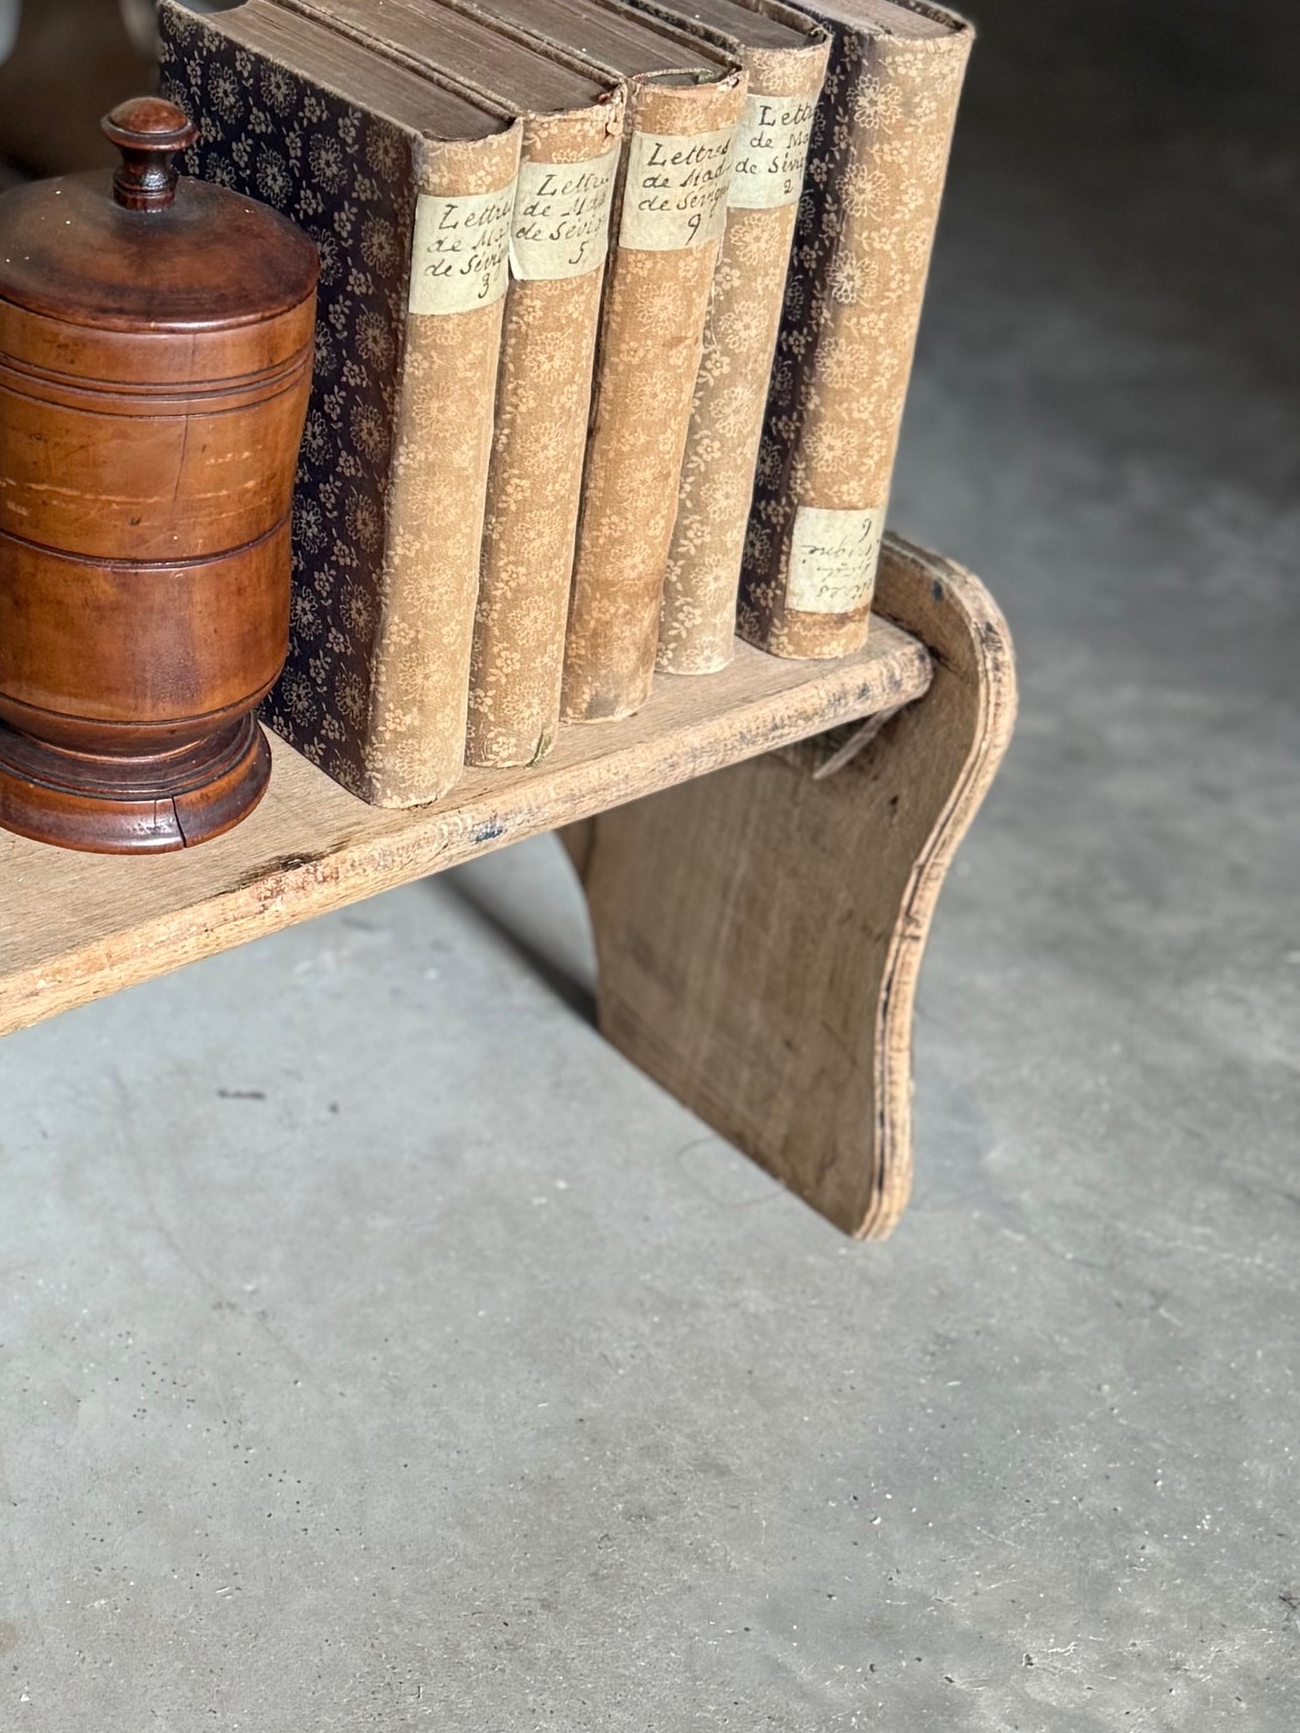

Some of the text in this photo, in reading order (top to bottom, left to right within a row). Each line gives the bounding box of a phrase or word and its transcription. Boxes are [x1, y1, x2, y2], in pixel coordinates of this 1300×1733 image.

[750, 131, 774, 148] de
[647, 137, 732, 167] Lettres
[735, 157, 758, 175] de
[642, 174, 672, 188] de
[783, 178, 794, 195] 2
[523, 201, 552, 217] de
[638, 195, 672, 211] de
[515, 222, 544, 241] de
[685, 213, 702, 246] 9
[427, 235, 462, 254] de
[568, 240, 589, 265] 5
[424, 258, 454, 277] de
[477, 272, 491, 299] 3
